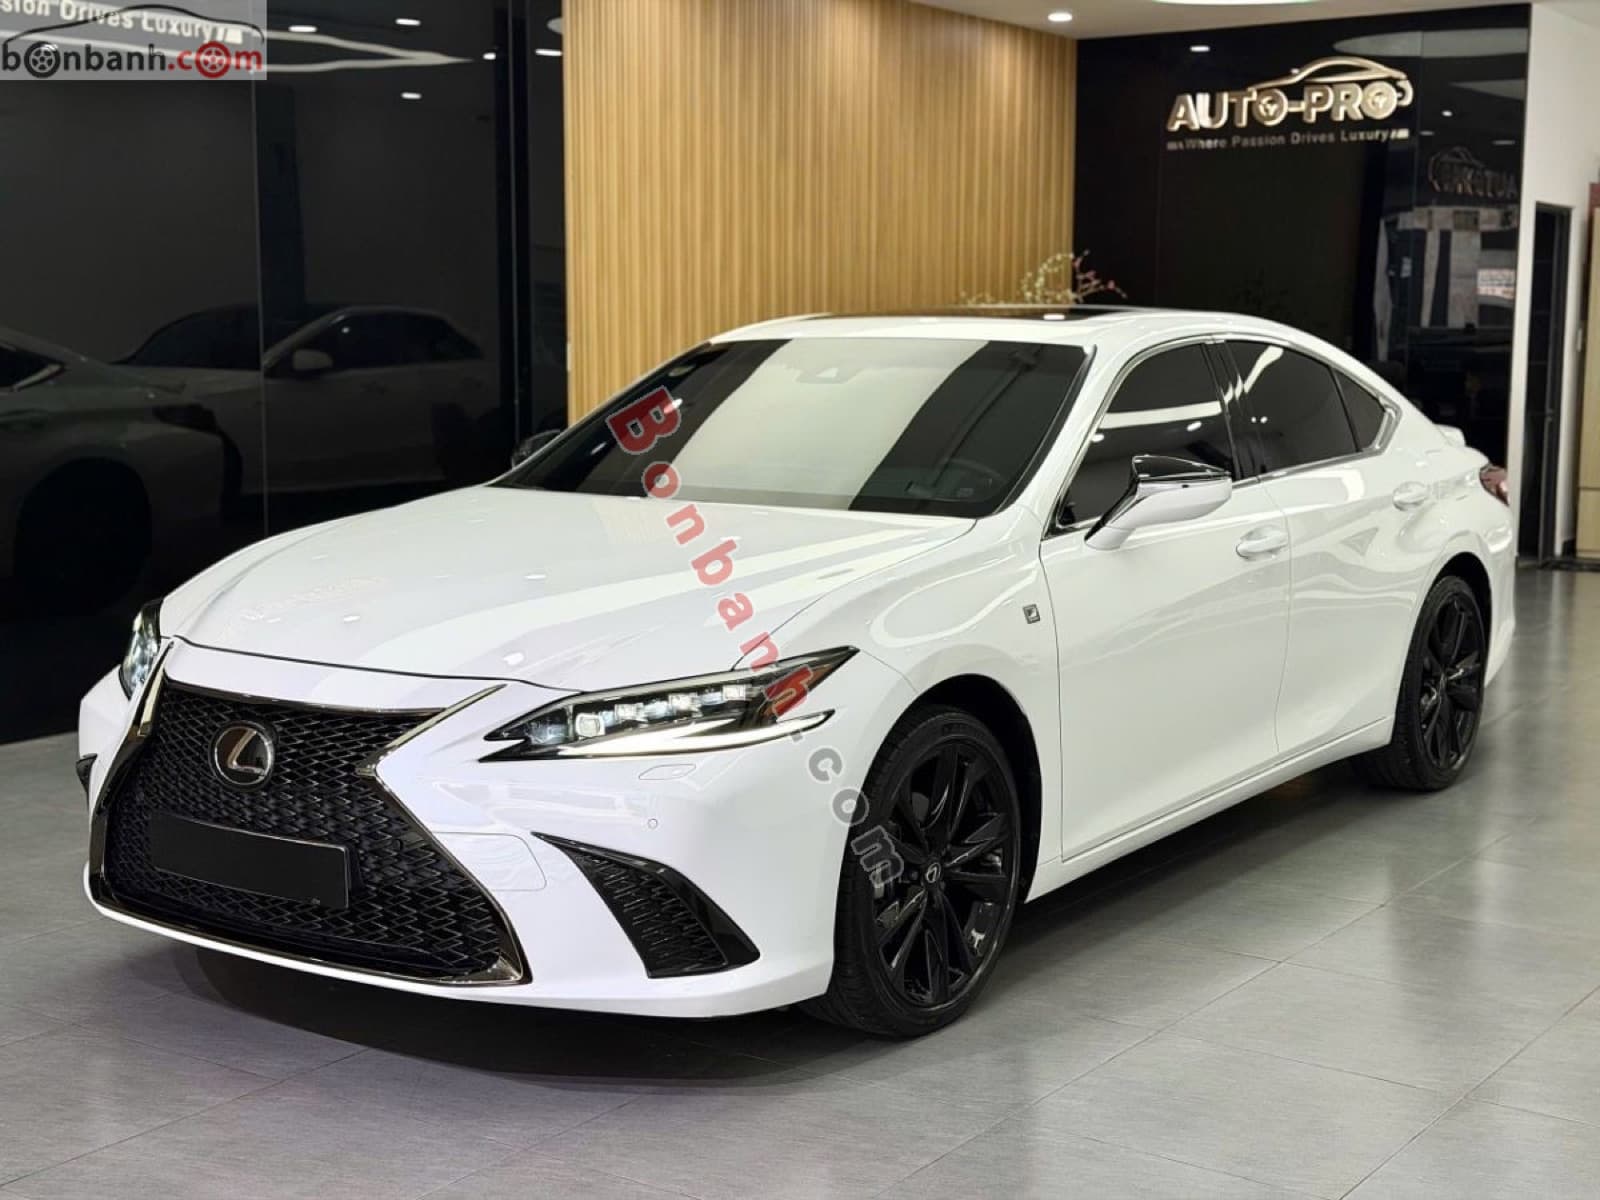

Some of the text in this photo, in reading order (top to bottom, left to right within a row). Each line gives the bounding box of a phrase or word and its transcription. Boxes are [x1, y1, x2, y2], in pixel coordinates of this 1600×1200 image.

[142, 13, 212, 43] Luxury
[1167, 81, 1398, 131] AUTO-PRO
[1231, 134, 1285, 147] Passion
[1290, 131, 1335, 144] Drives
[1340, 128, 1390, 143] Luxury
